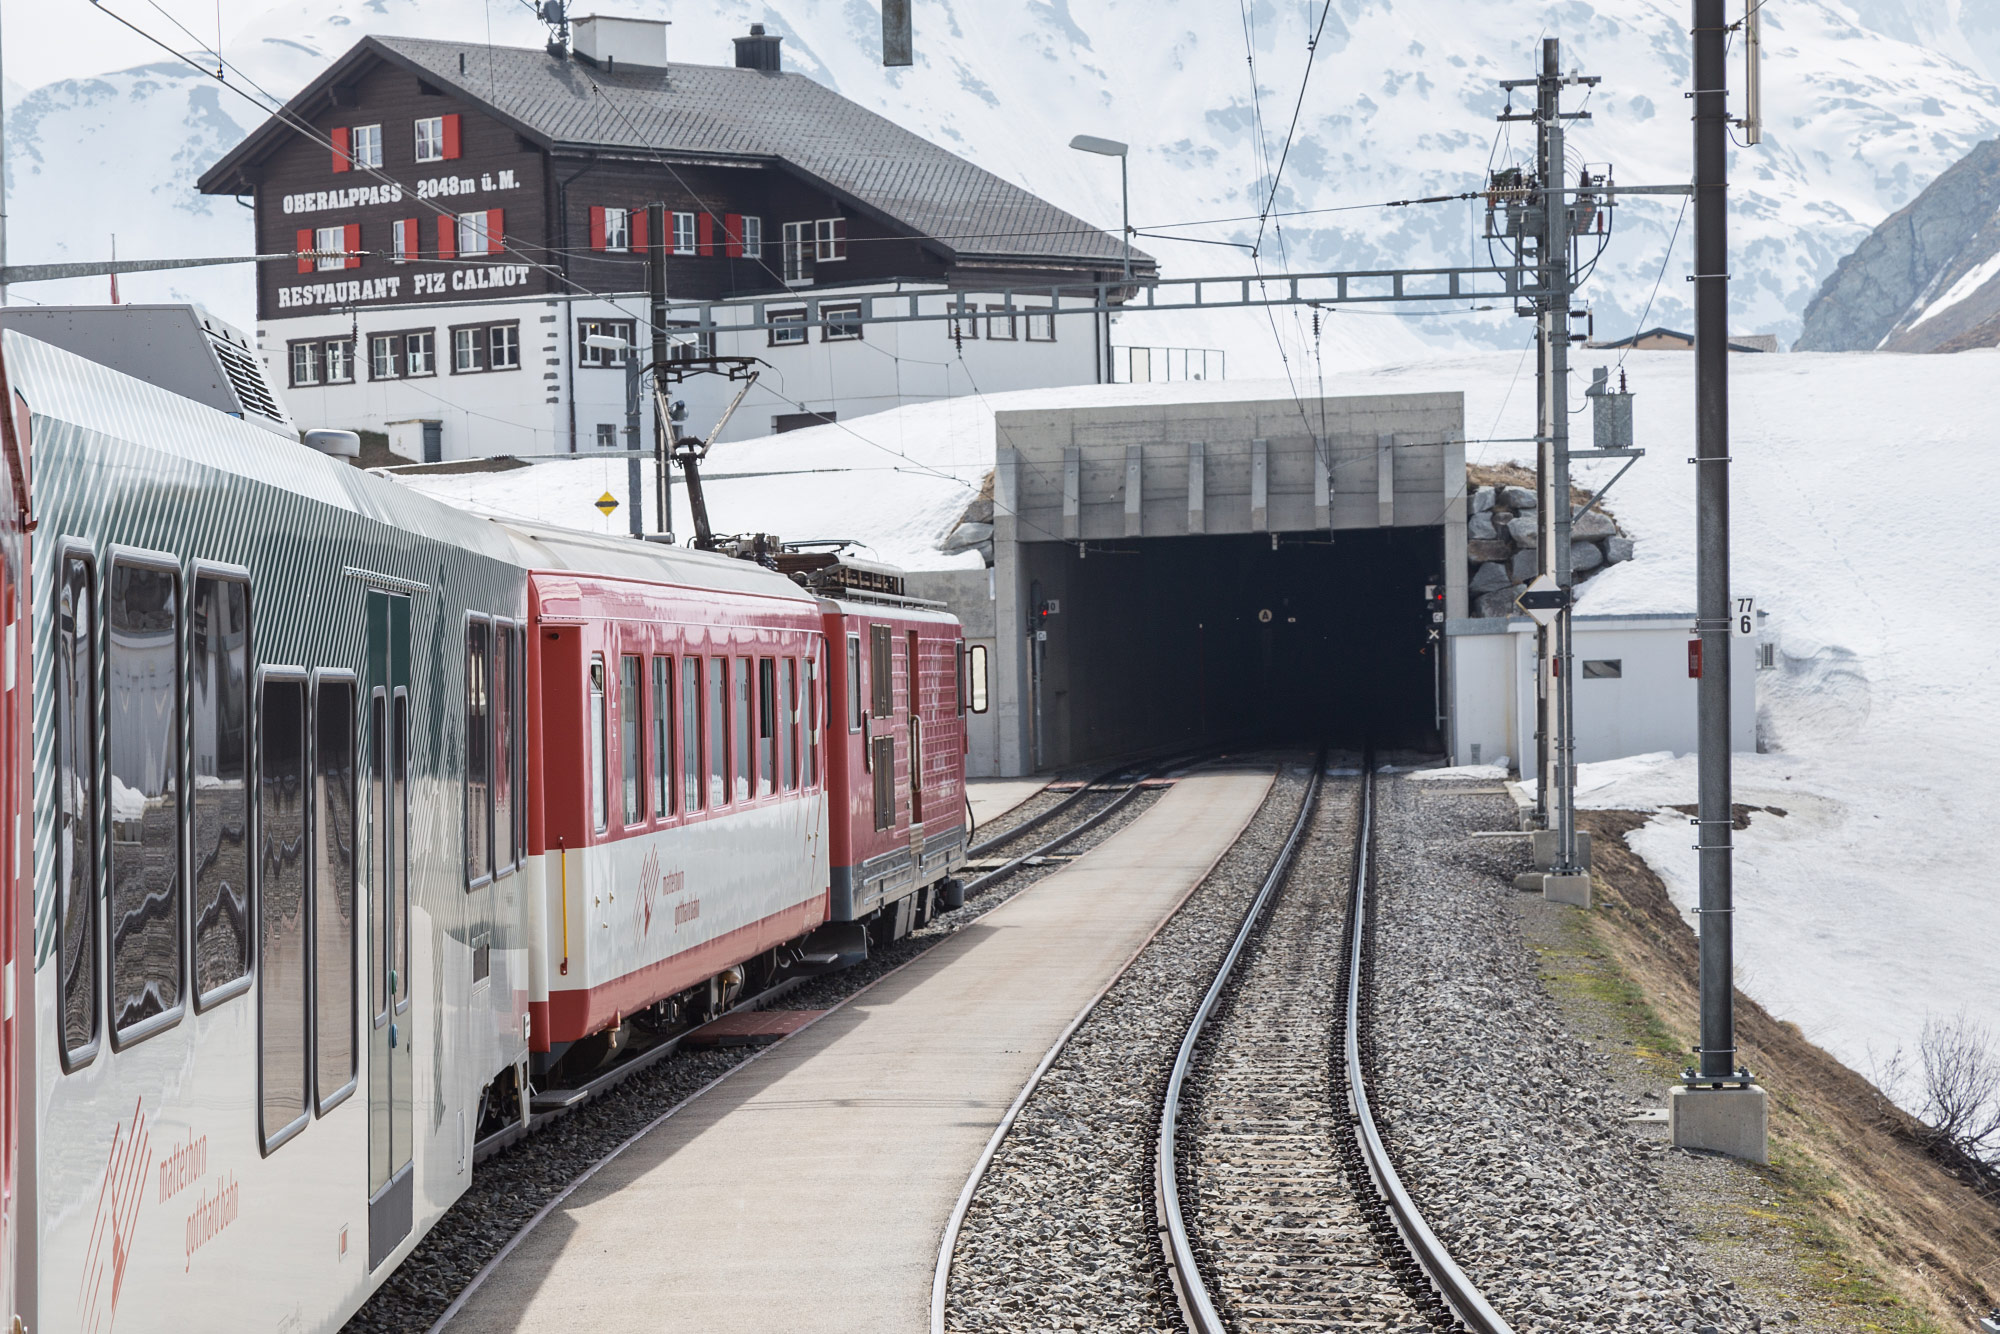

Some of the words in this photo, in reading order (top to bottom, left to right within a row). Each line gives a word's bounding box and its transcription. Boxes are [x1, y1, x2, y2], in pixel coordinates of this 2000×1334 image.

[283, 183, 402, 214] OBERALPPASS
[417, 176, 475, 200] 2048m
[278, 276, 400, 308] RESTAURANT
[414, 273, 446, 295] PIZ
[452, 266, 529, 291] CALMOT
[1737, 598, 1753, 612] 77
[1740, 615, 1752, 634] 6
[159, 1126, 206, 1205] matterhorn
[186, 1177, 220, 1273] gotthard
[221, 1168, 238, 1231] bahn
